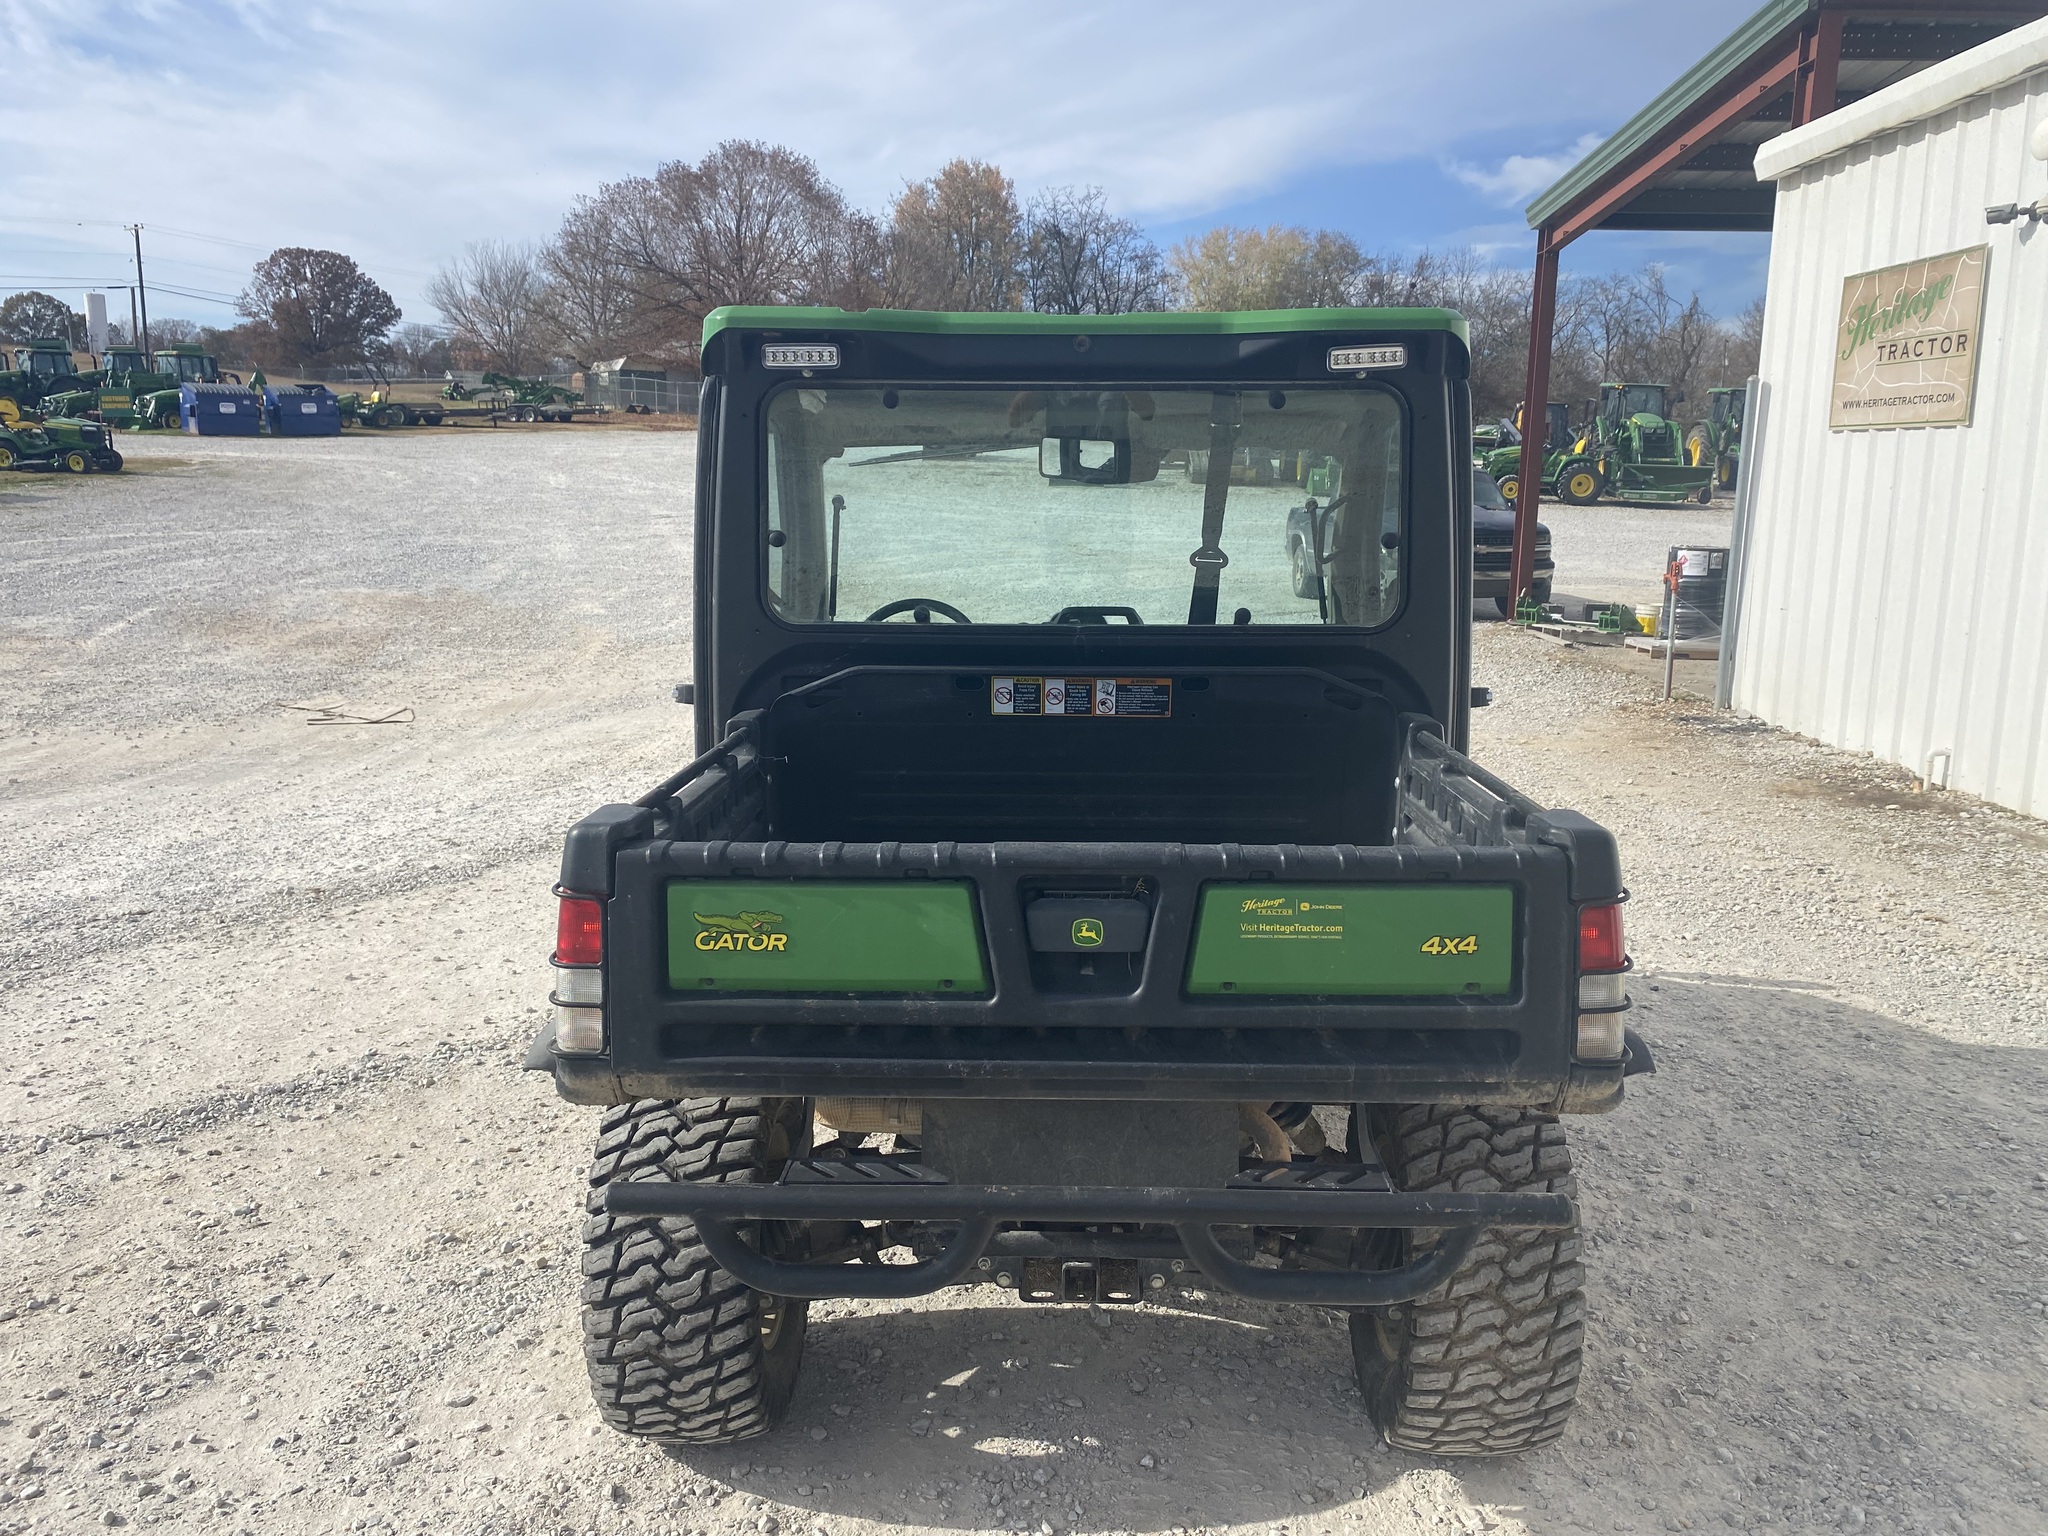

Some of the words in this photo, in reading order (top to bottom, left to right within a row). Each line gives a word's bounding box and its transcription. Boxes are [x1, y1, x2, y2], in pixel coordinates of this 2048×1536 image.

[1842, 273, 1953, 361] Heritage
[1877, 334, 1968, 362] TRACTOR
[1842, 393, 1955, 410] WWW.HERITAGETRACTOR.COM
[1241, 898, 1285, 912] Heritage
[1240, 923, 1257, 932] Visit
[1259, 923, 1343, 933] HeritageTractor.com
[695, 931, 788, 951] GATOR
